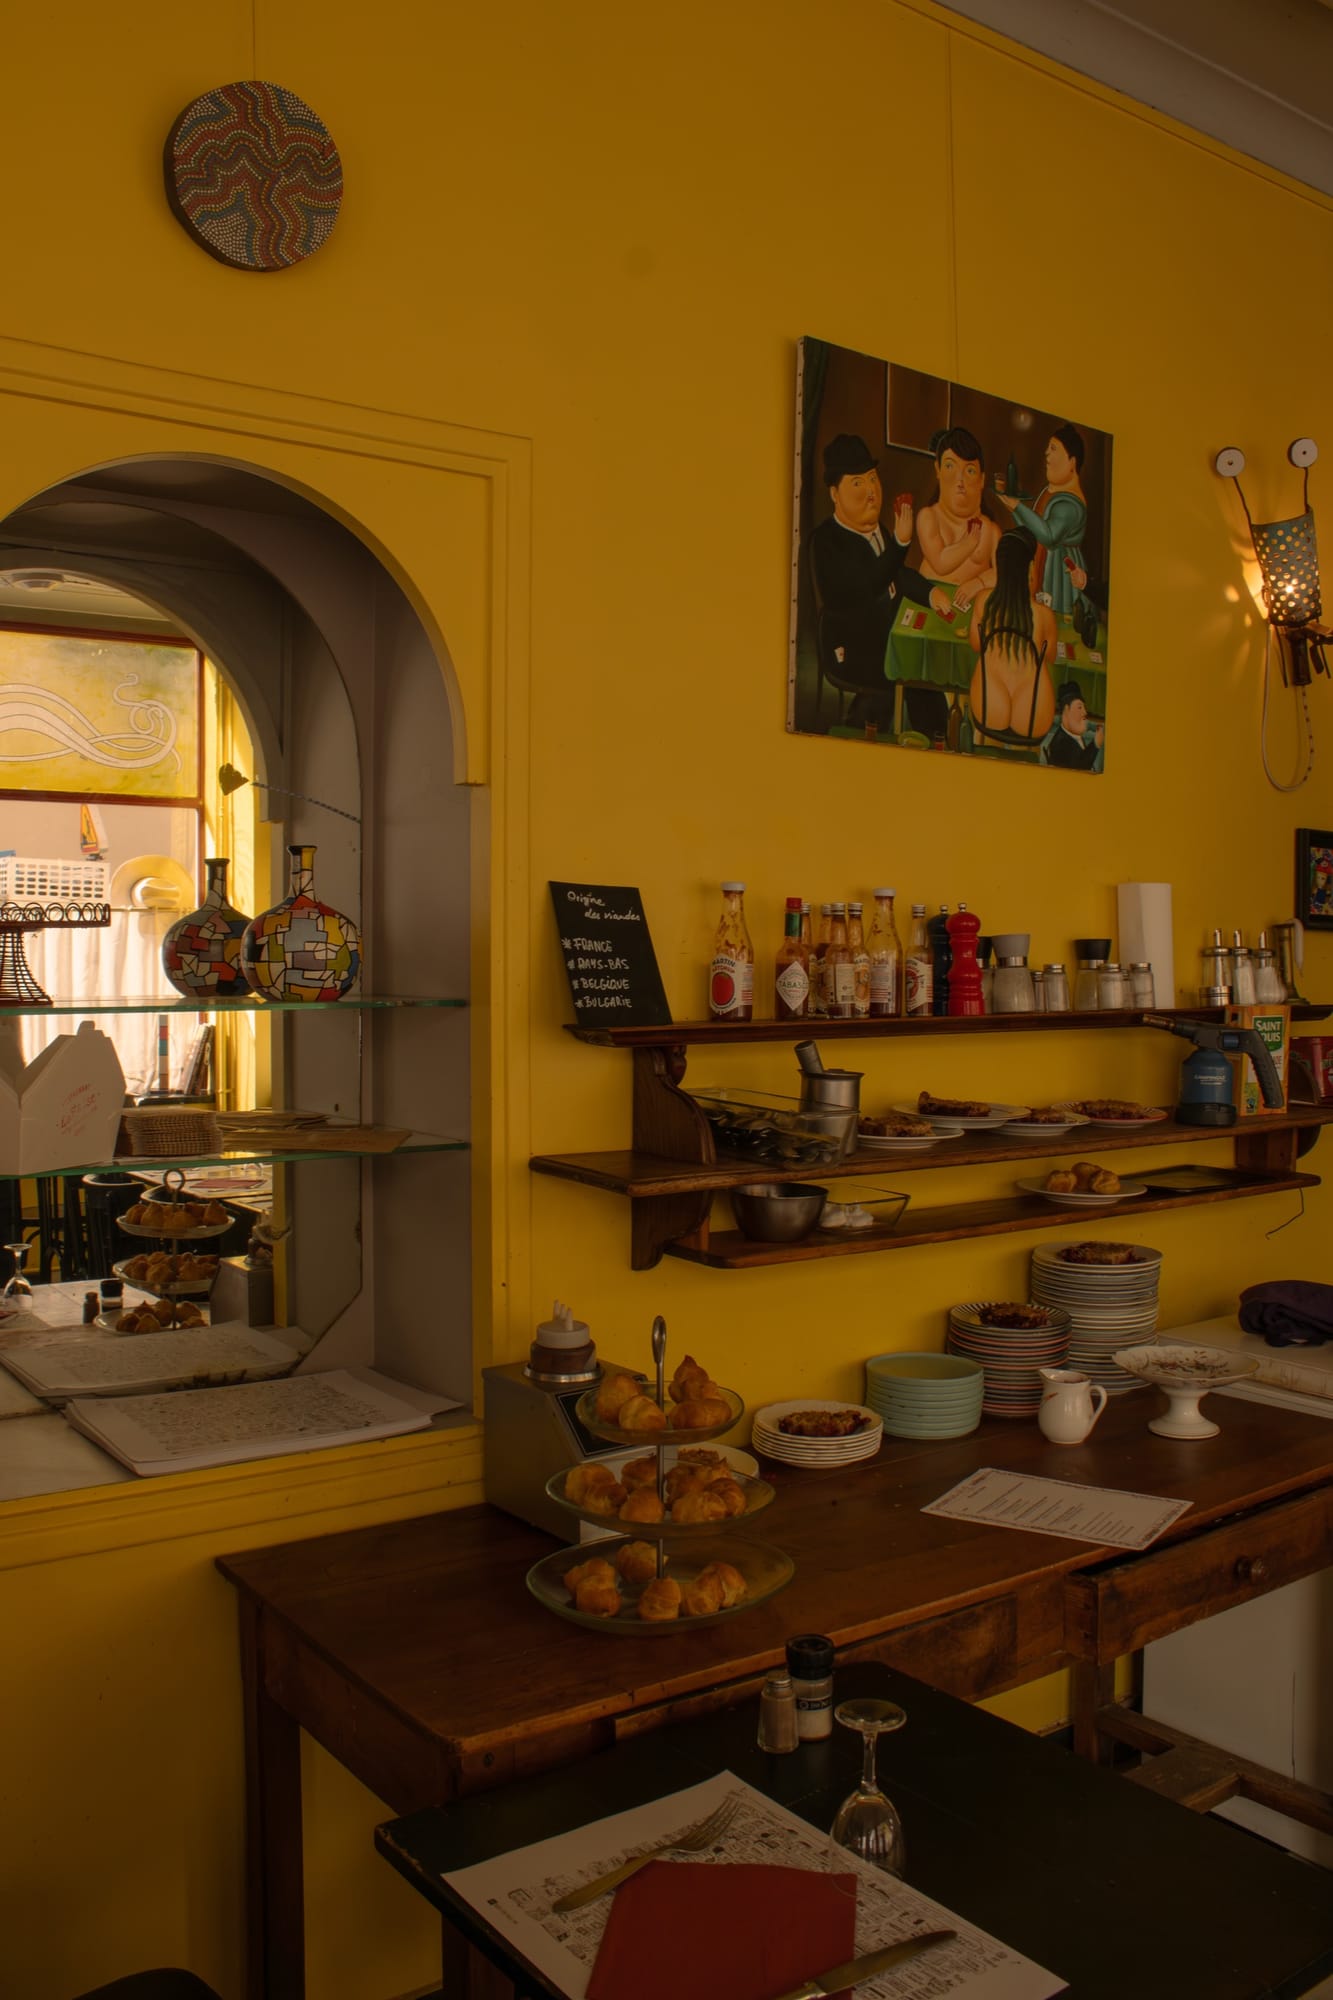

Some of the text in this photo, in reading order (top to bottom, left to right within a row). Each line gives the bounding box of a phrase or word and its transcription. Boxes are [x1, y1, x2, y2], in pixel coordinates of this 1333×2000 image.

[567, 890, 606, 907] Origine
[584, 906, 641, 921] des viandes
[573, 937, 613, 953] FRANCE
[577, 957, 630, 970] PAYS-BAS
[1256, 1020, 1281, 1031] SAINT
[1263, 1032, 1281, 1042] OUIS
